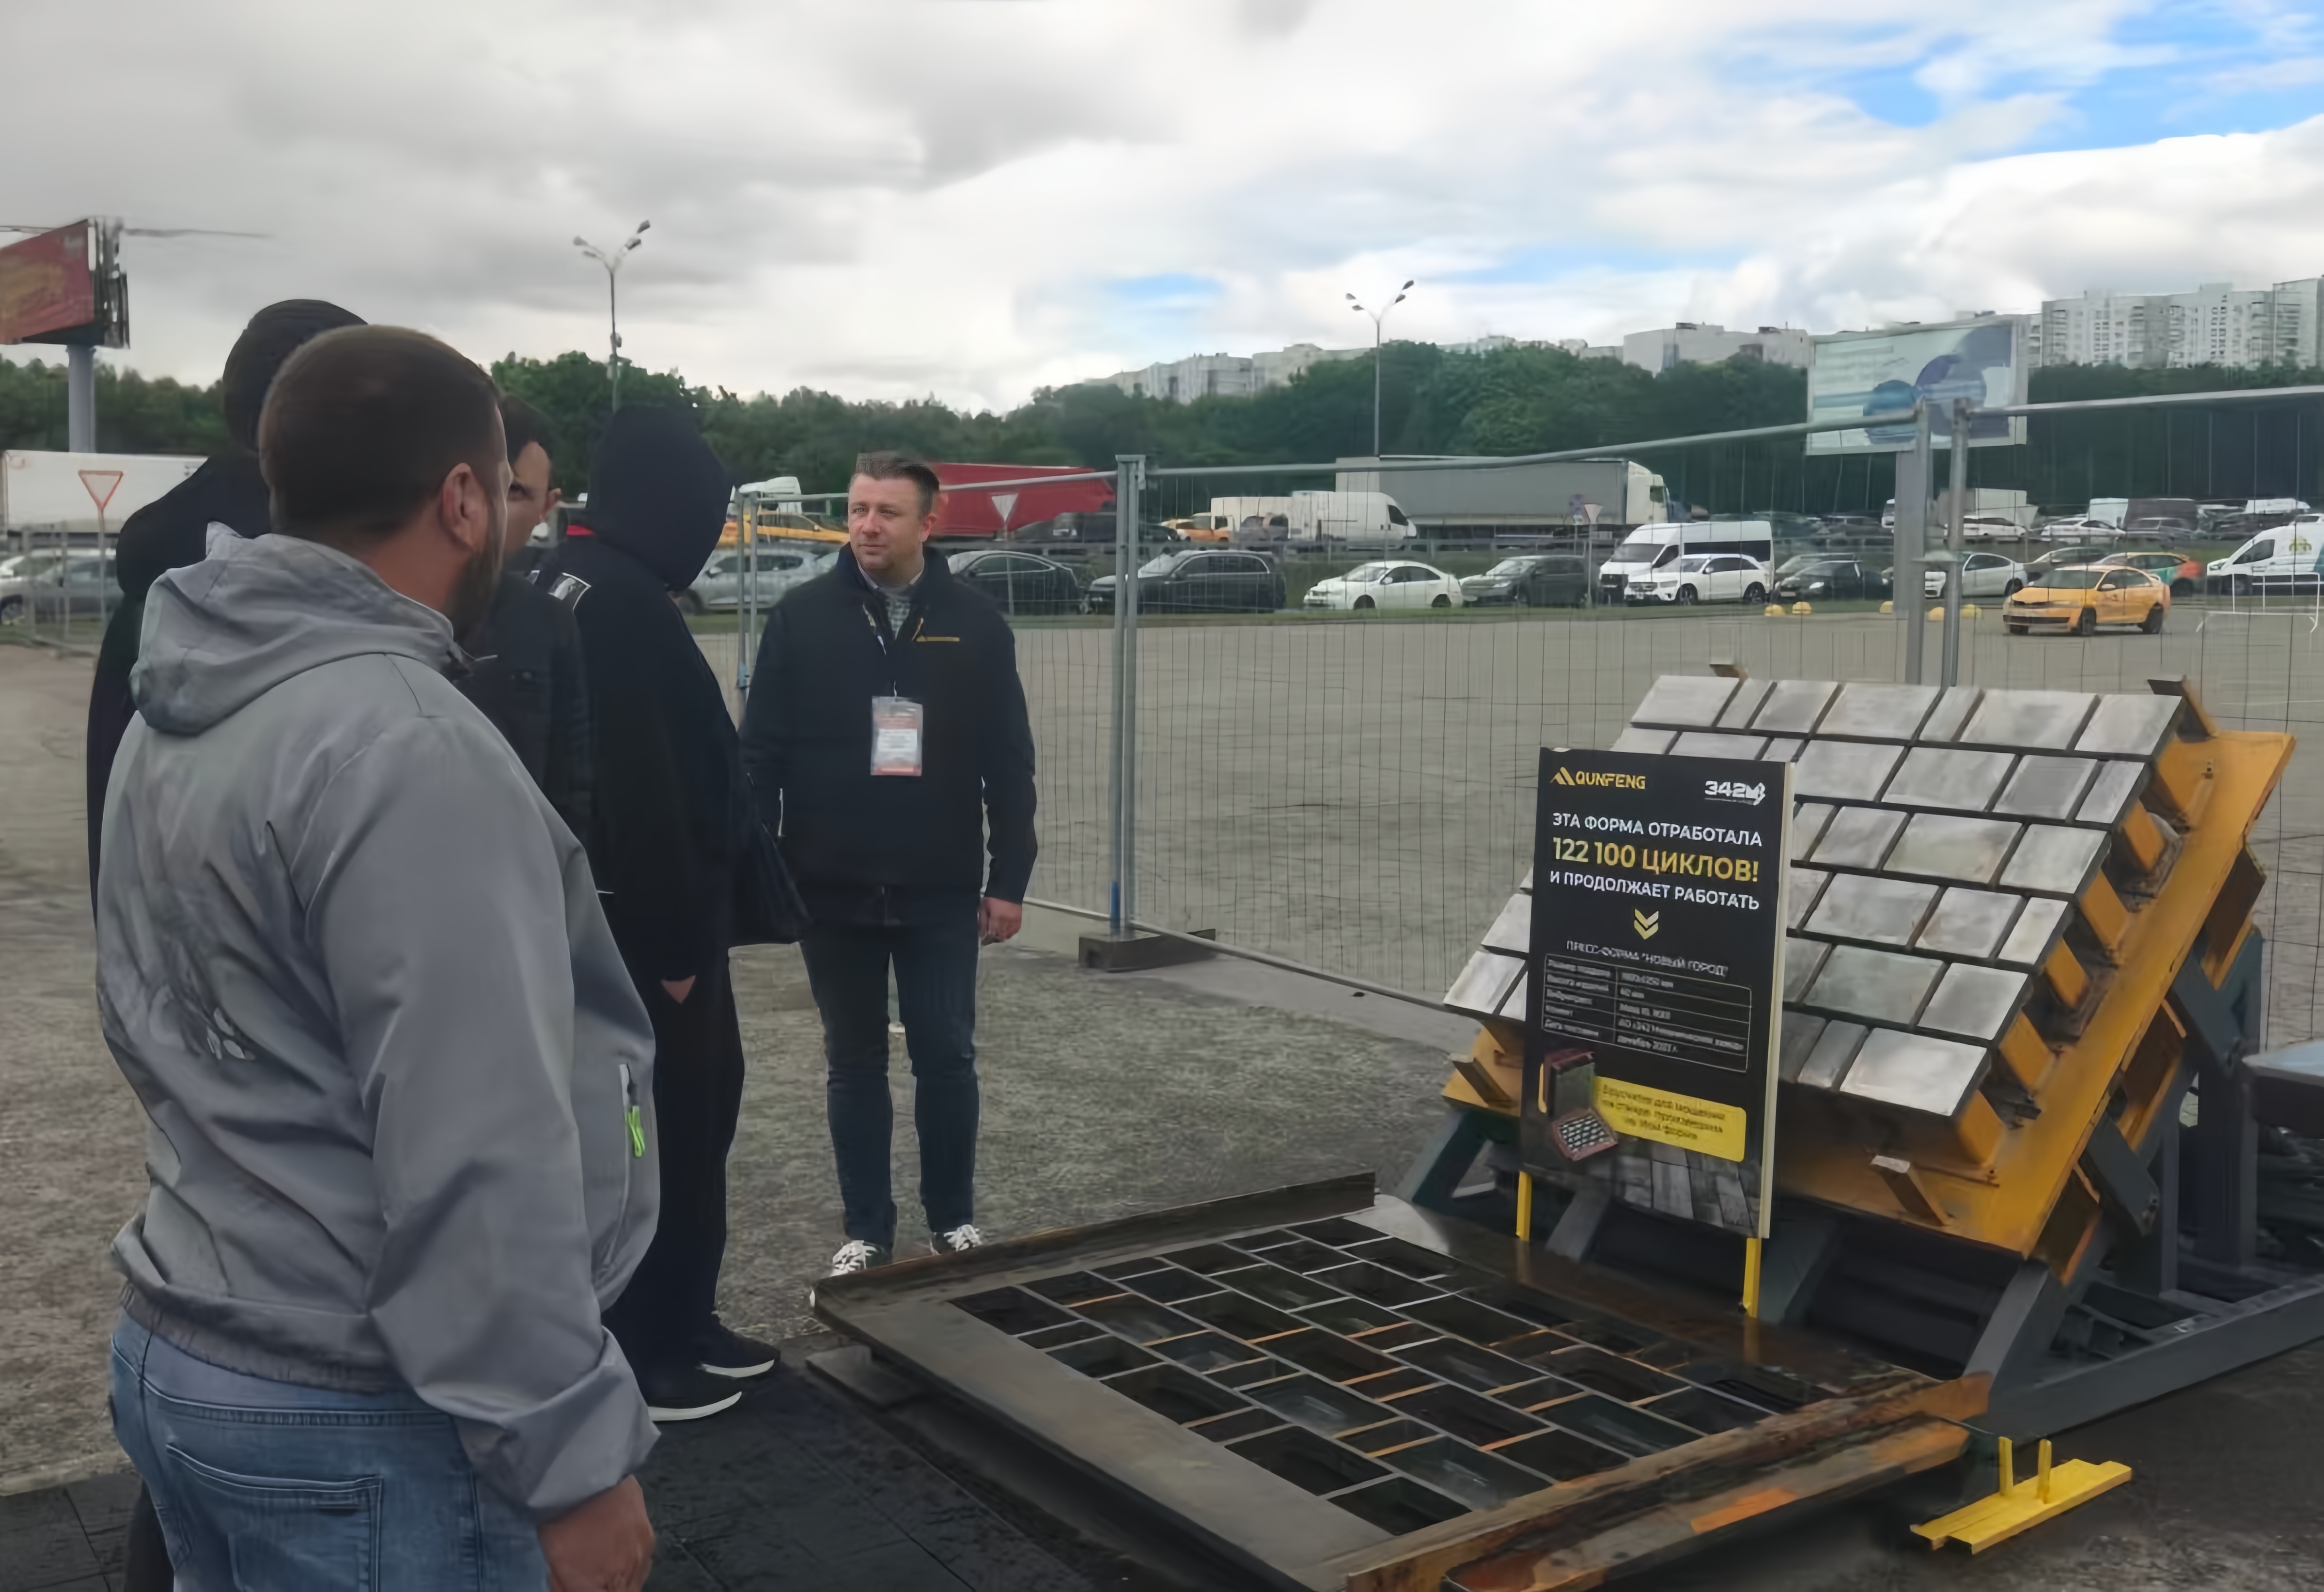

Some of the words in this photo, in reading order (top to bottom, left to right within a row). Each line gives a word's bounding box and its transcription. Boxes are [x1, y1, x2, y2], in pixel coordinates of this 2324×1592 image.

[1576, 771, 1646, 789] QUNFENG
[1553, 813, 1580, 828] ЭТА
[1584, 815, 1644, 834] ФОРМА
[1648, 821, 1762, 847] ОТРАБОТАЛА
[1553, 837, 1589, 863] 122
[1594, 842, 1635, 868] 100
[1642, 849, 1759, 882] ЦИКЛОВ!
[1550, 870, 1560, 884] И
[1564, 871, 1670, 899] ПРОДОЛЖАЕТ
[1674, 886, 1760, 910] РАБОТАТЬ
